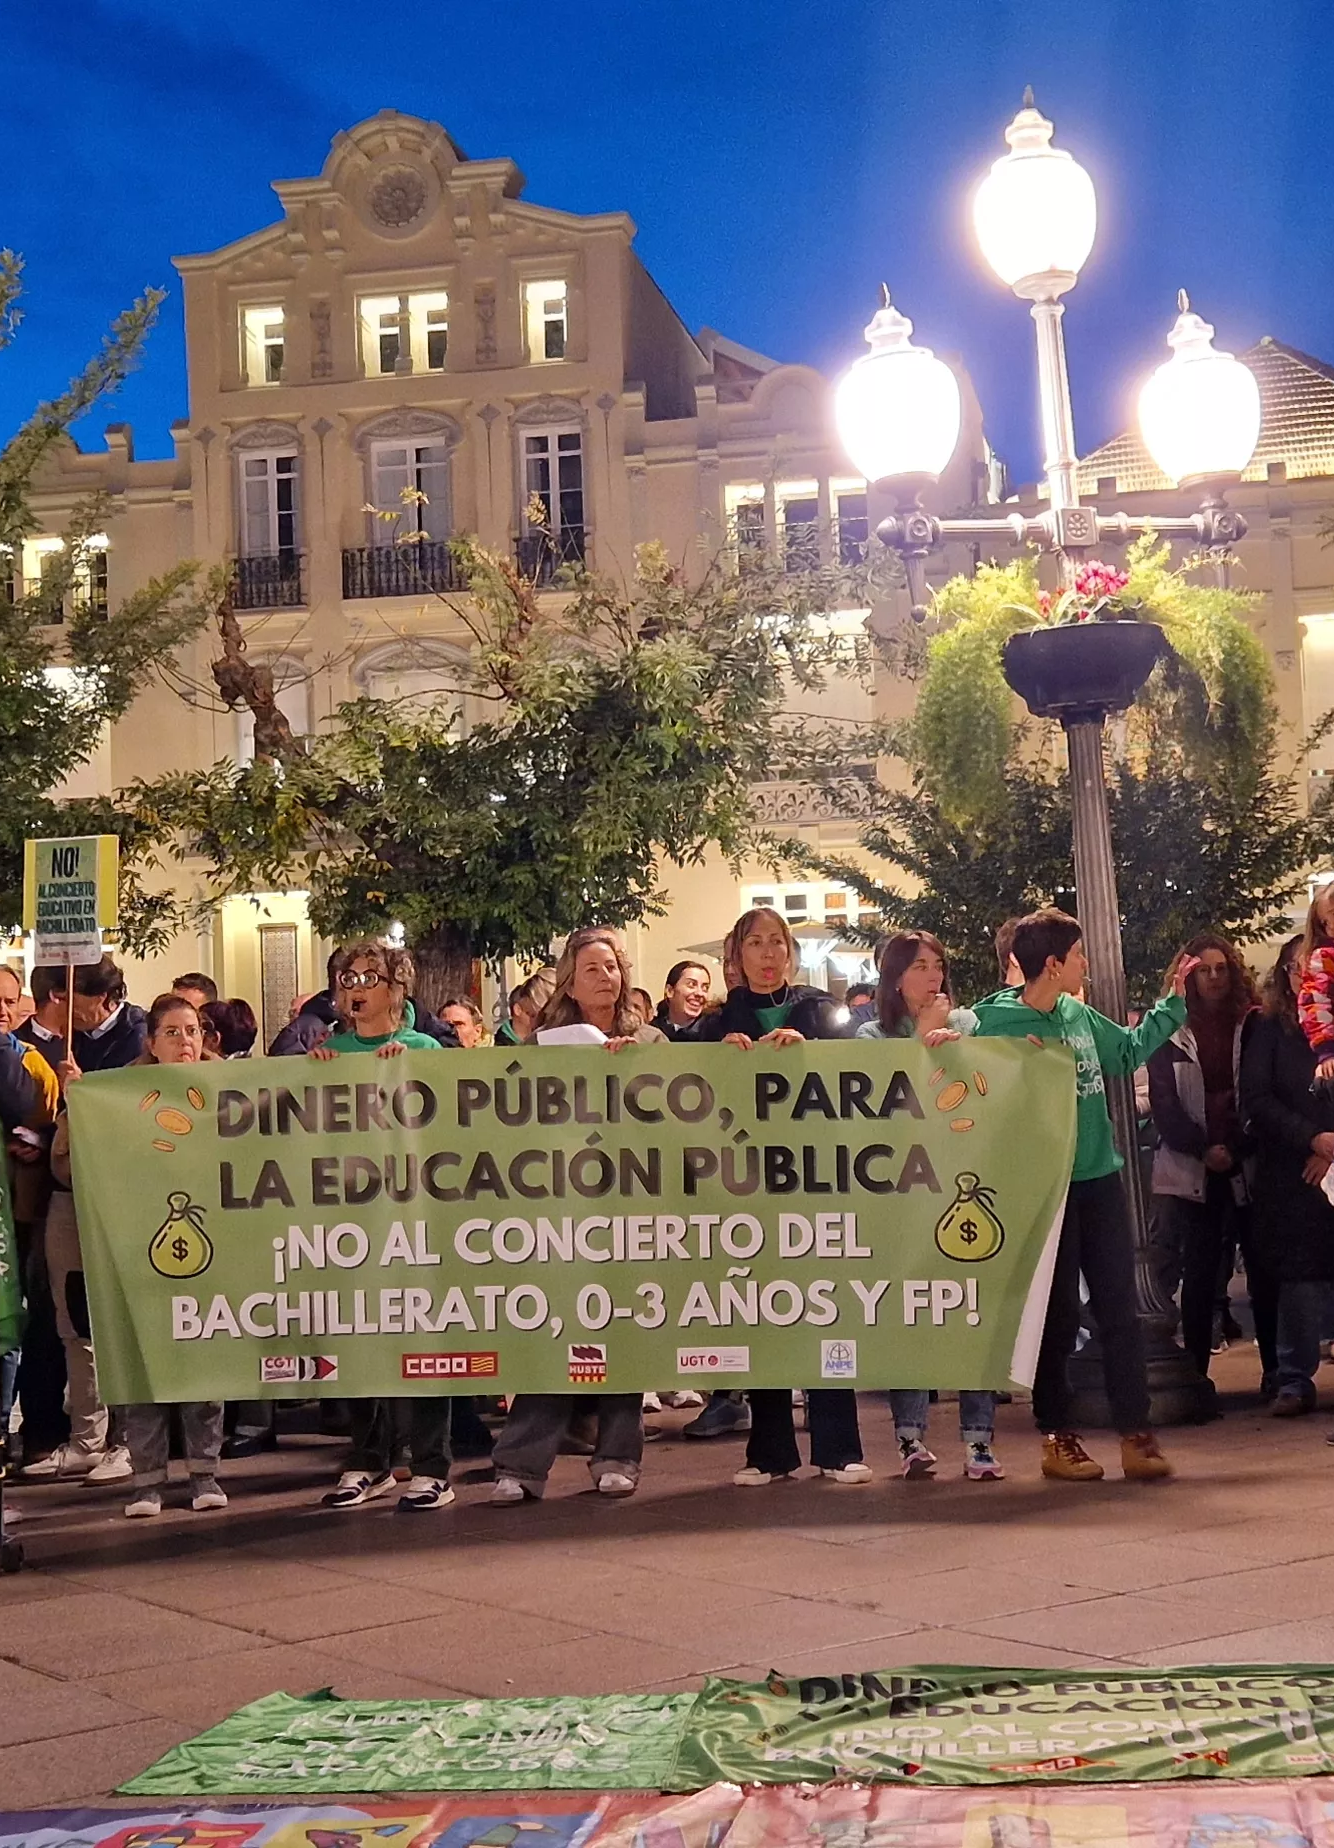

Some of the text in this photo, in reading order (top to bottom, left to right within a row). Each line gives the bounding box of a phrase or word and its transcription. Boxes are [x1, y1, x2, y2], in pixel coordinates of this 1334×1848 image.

[51, 846, 80, 878] NO!
[217, 1060, 926, 1138] DINERO PÚBLICO, PARA
[219, 1129, 943, 1209] LA EDUCACIÓN PÚBLICA
[272, 1212, 873, 1283] ¡NO AL CONCIERTO DEL
[171, 1266, 982, 1341] BACHILLERATO, 0-3 AÑOS Y FP!
[265, 1356, 294, 1369] CGT
[406, 1357, 467, 1374] CCOO
[679, 1355, 705, 1367] UGT
[957, 1721, 1034, 1737] AL
